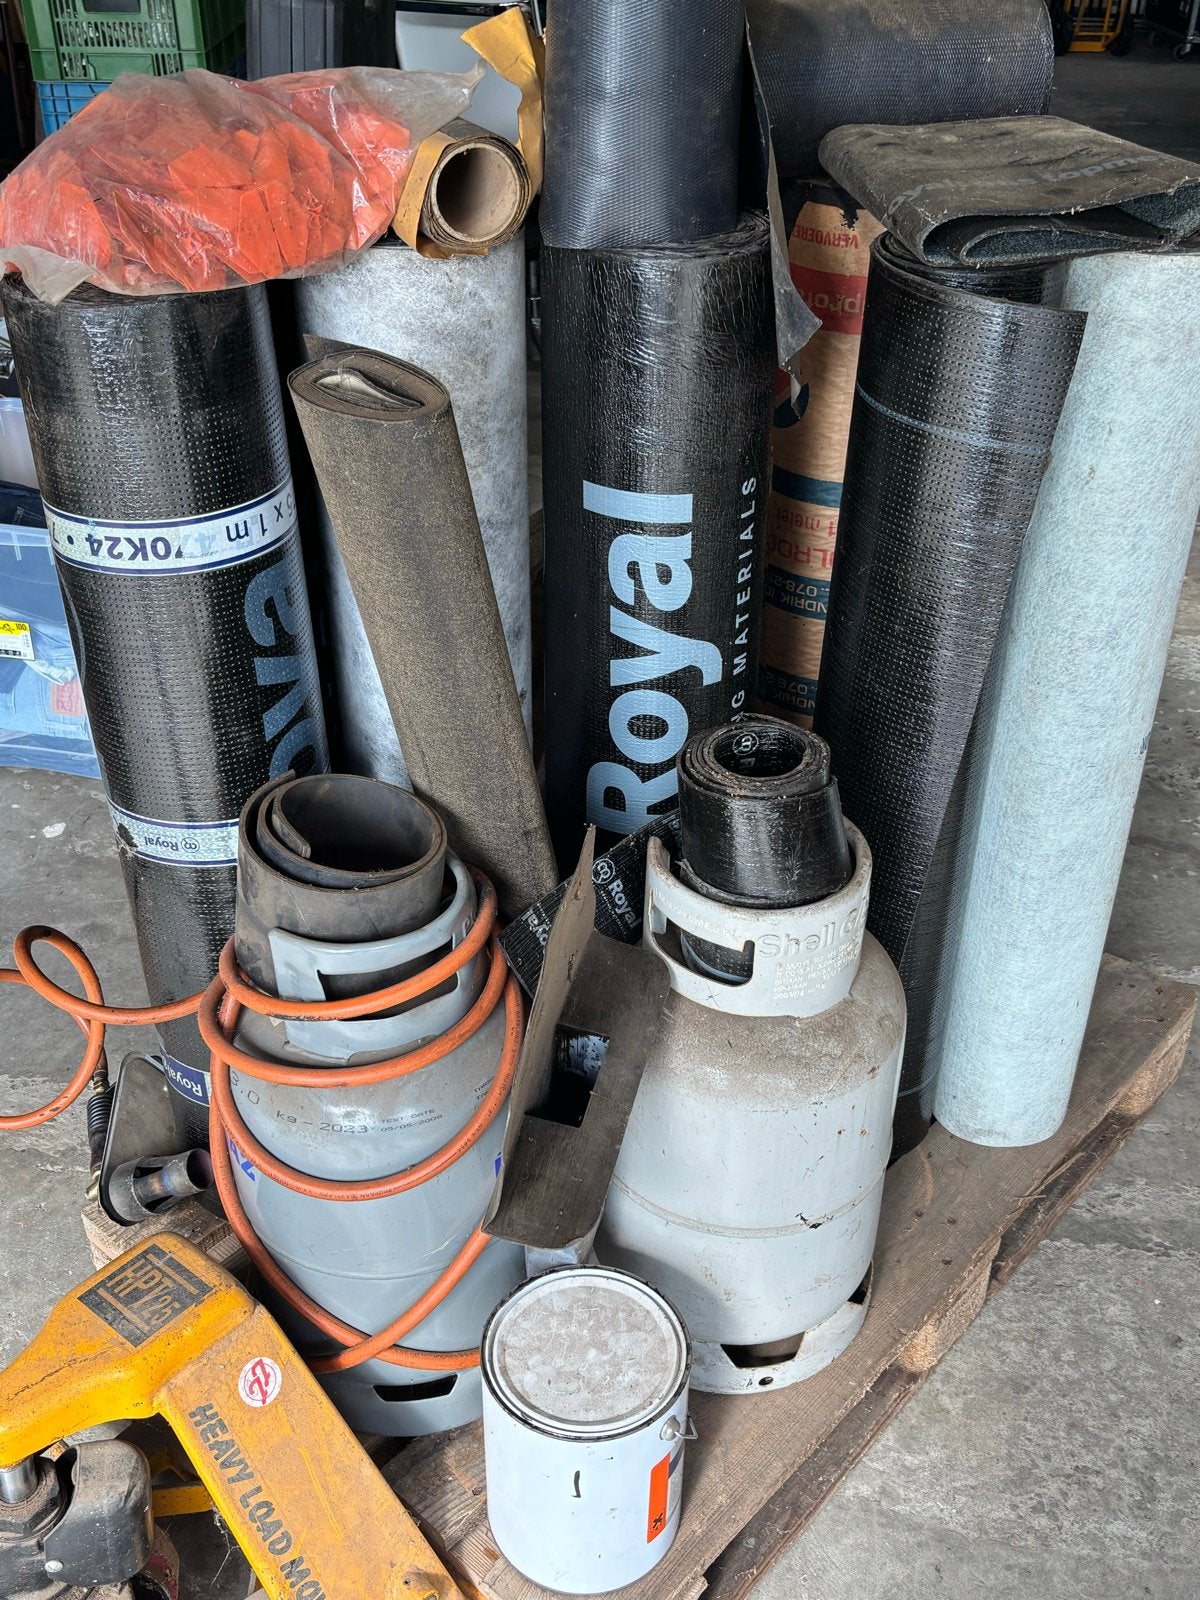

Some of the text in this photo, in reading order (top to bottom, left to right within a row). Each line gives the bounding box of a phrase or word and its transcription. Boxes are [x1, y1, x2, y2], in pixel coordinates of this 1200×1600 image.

[225, 520, 250, 544] m
[732, 477, 757, 676] MATERIALS
[583, 481, 722, 835] Royal
[144, 836, 180, 852] Royal
[608, 878, 643, 930] Royal
[758, 920, 836, 958] Shell
[276, 1110, 297, 1125] kg
[319, 1121, 369, 1135] 2023
[380, 1107, 436, 1125] TEST DATE
[188, 1402, 255, 1485] HEAVY
[239, 1485, 293, 1556] LOAD
